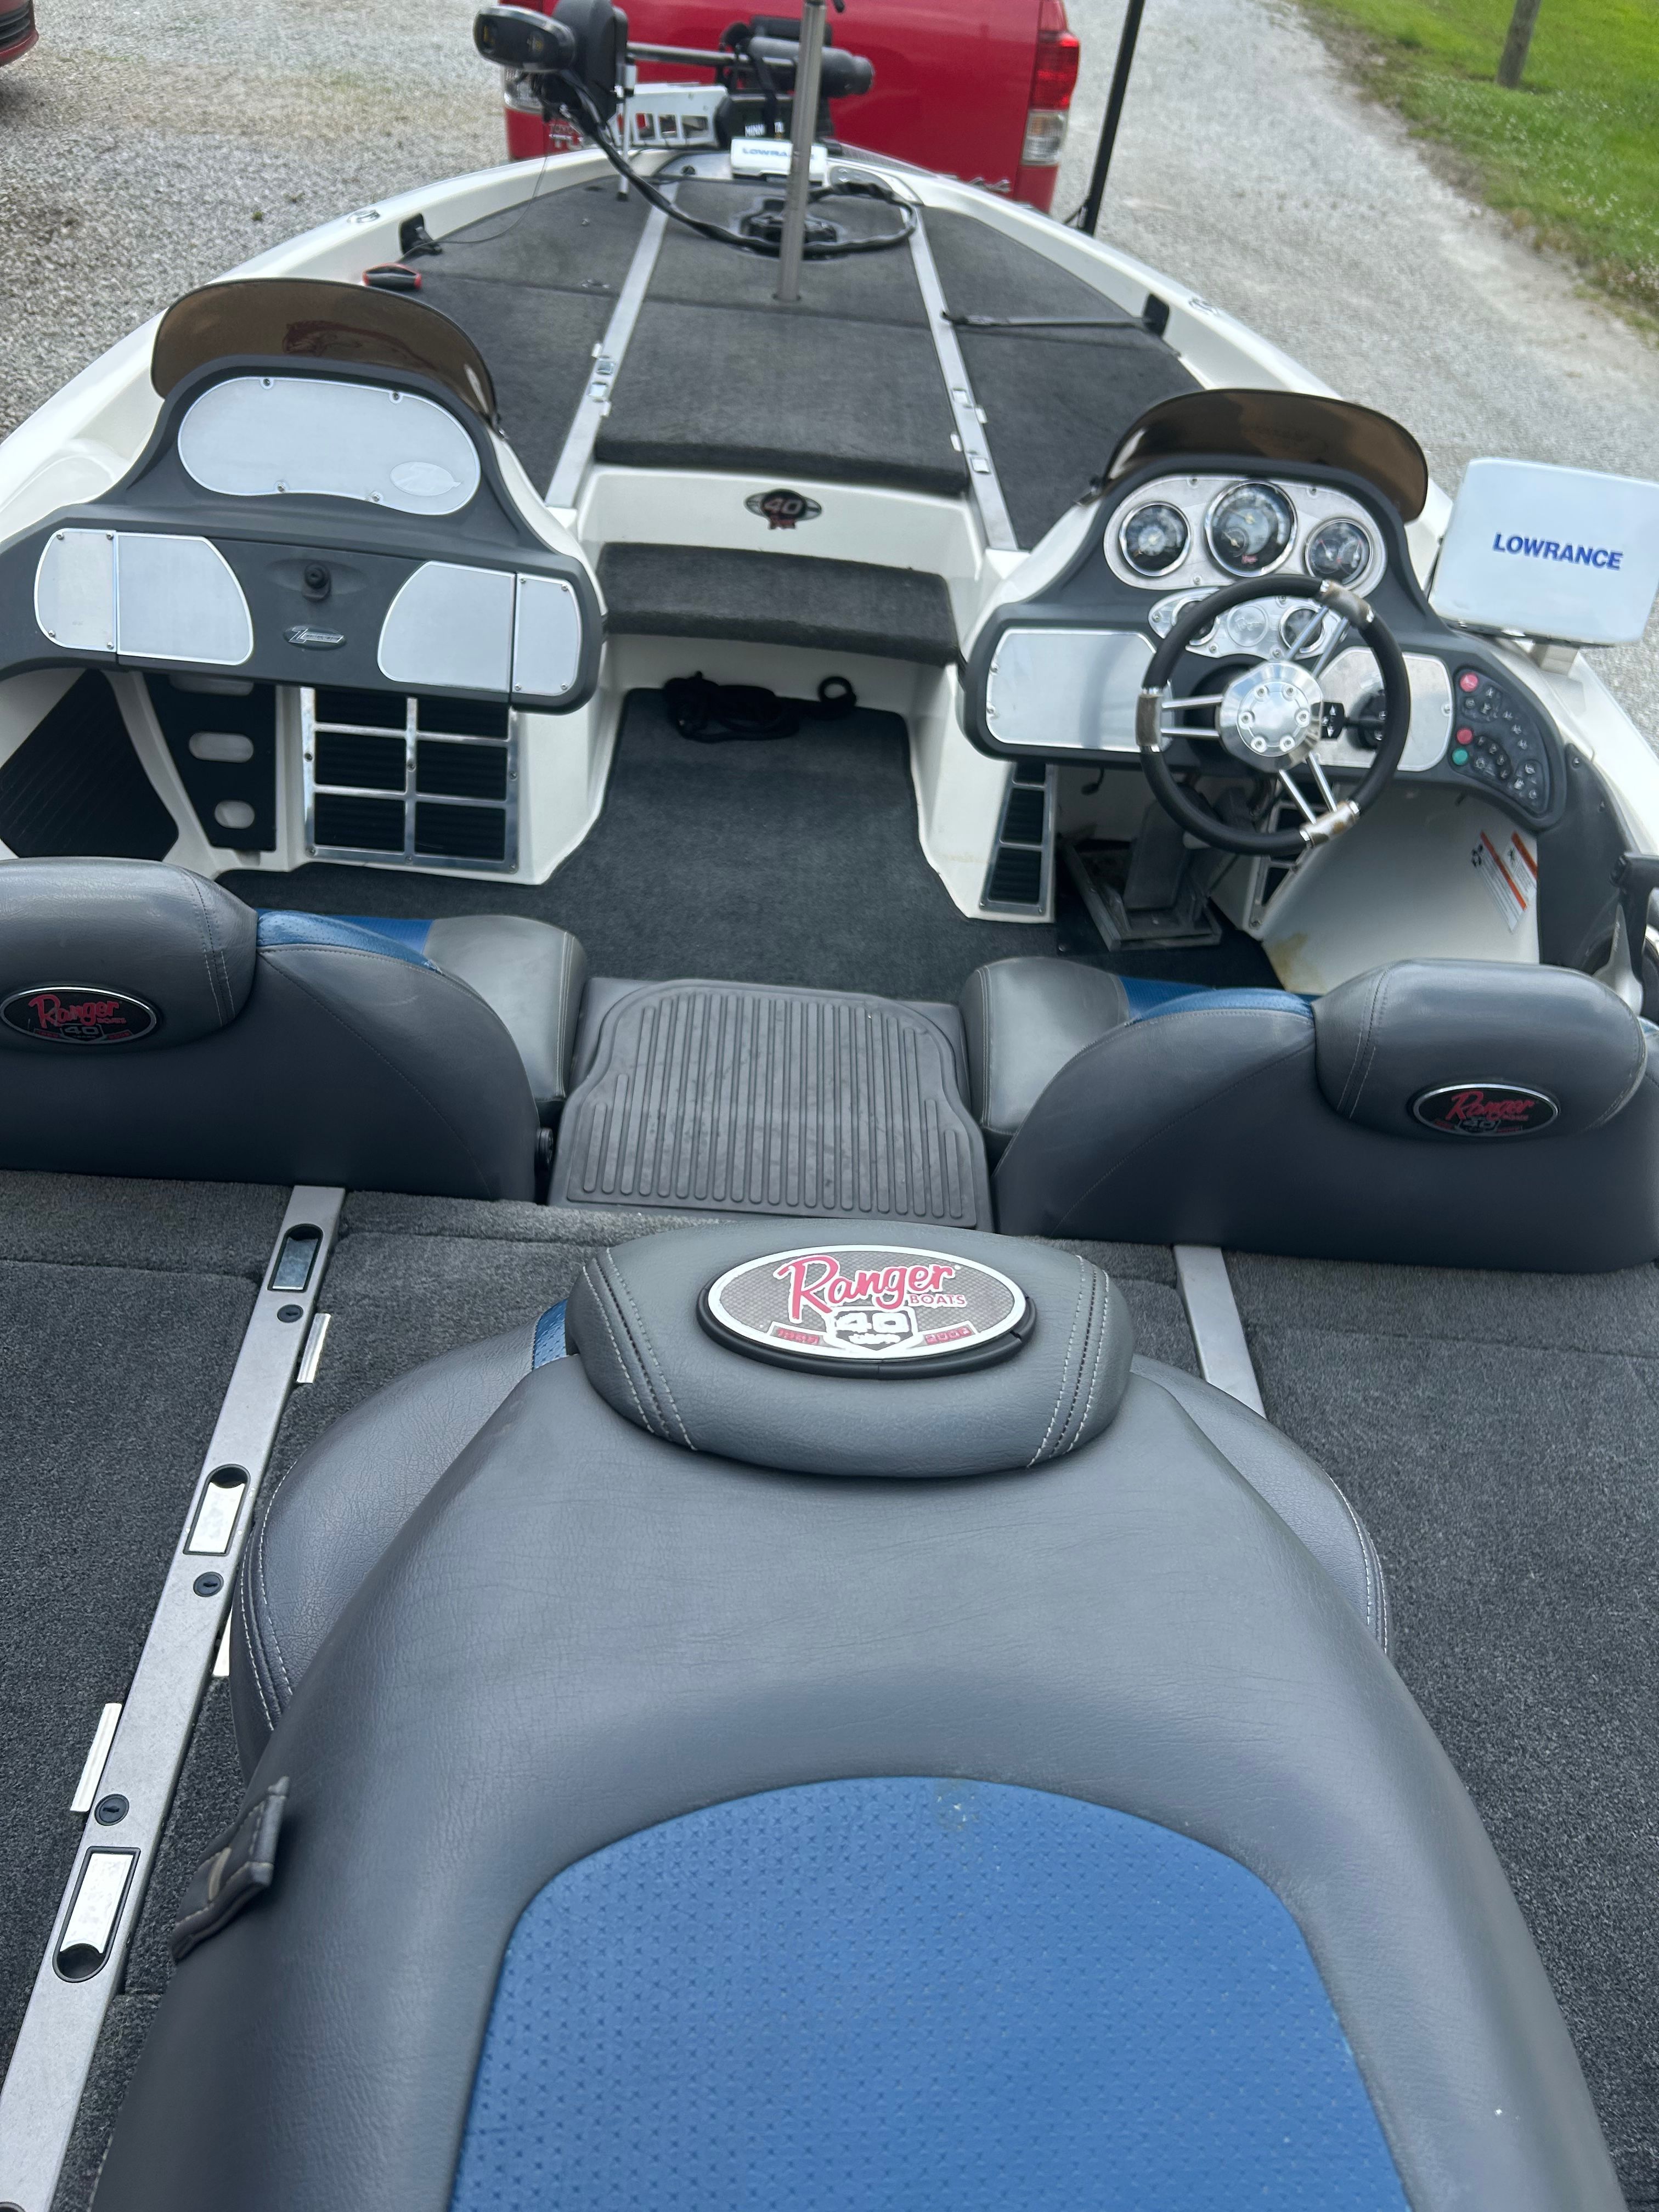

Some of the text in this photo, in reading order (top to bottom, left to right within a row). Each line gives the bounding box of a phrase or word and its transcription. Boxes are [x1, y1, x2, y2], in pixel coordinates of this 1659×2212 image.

[1493, 532, 1623, 571] LOWRANCE
[28, 994, 120, 1029] Ranger
[1445, 1090, 1534, 1121] Ranger
[777, 1254, 955, 1321] Ranger
[908, 1294, 966, 1306] BOATS
